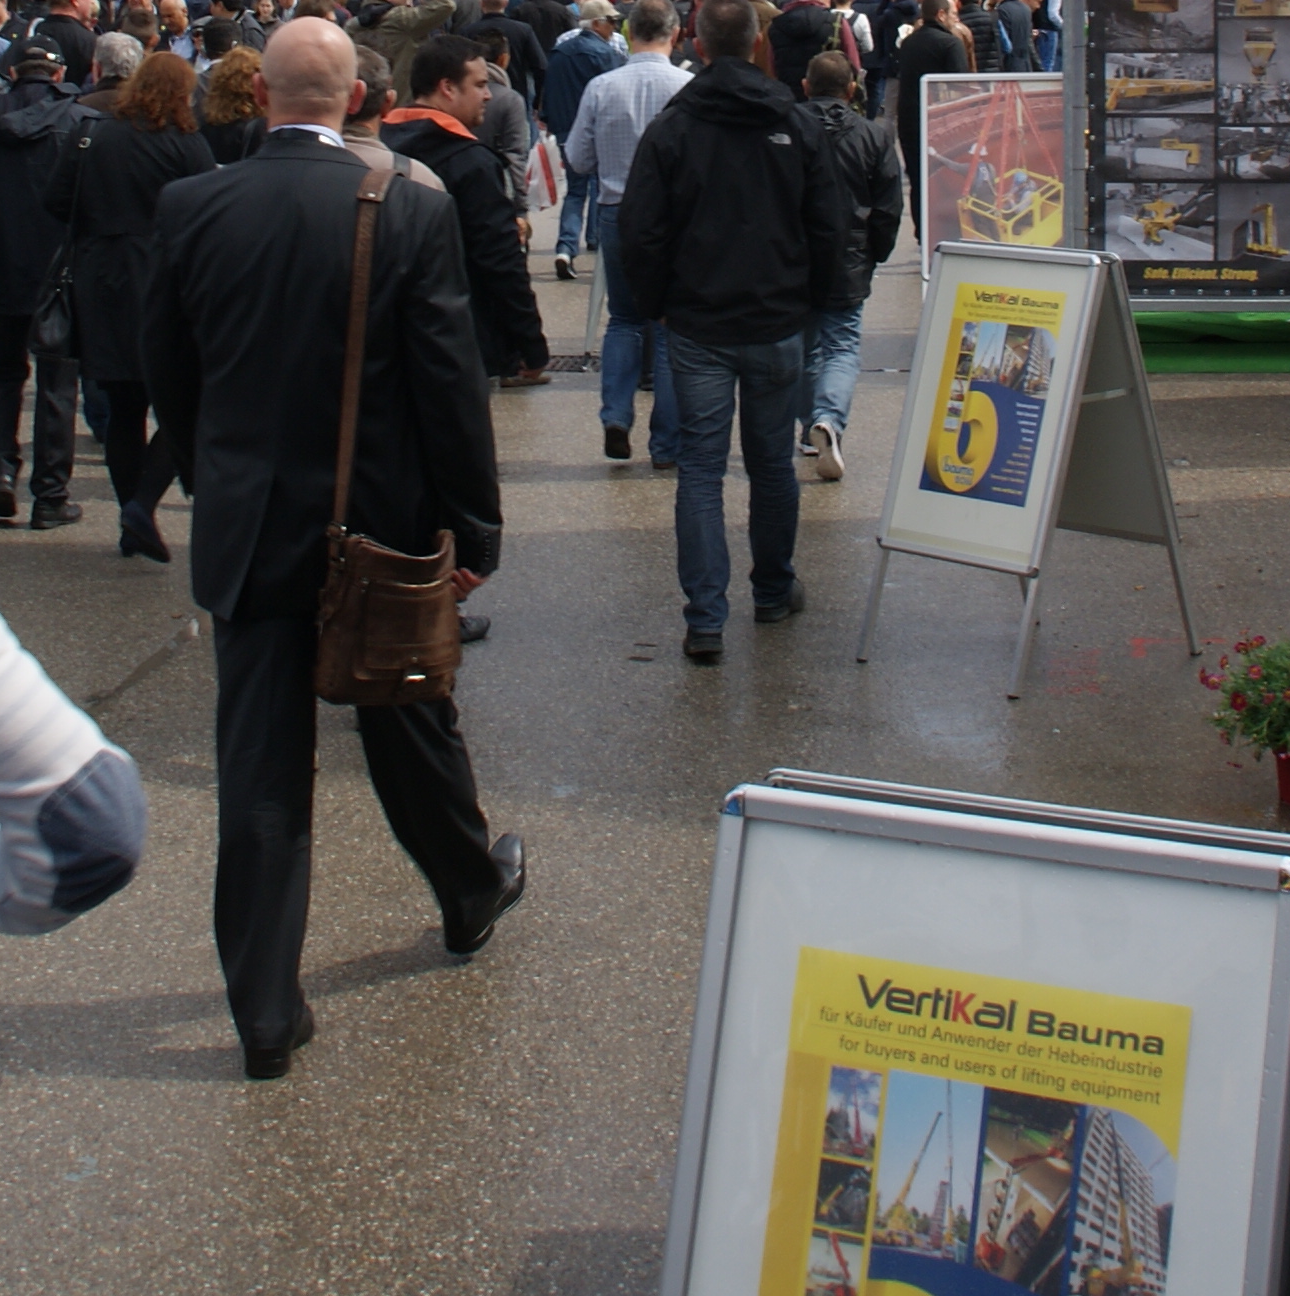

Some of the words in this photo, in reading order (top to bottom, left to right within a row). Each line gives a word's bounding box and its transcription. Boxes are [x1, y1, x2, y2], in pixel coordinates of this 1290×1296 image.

[974, 289, 1020, 306] VertiKal
[1021, 297, 1059, 309] Bauma
[1143, 267, 1169, 279] Safe.
[1171, 267, 1218, 279] Efficient.
[1220, 267, 1258, 281] Strong.
[819, 1007, 839, 1024] für
[844, 1010, 893, 1033] Käufer
[897, 1022, 927, 1040] und
[931, 1027, 1012, 1055] Anwender
[1017, 1042, 1044, 1060] der
[1048, 1047, 1163, 1079] Hebeindustrie
[857, 974, 1017, 1032] VertiKal
[1026, 1009, 1165, 1055] Bauma
[838, 1035, 859, 1051] for
[864, 1038, 916, 1064] buyers
[920, 1051, 950, 1069] and
[954, 1057, 997, 1077] users
[1001, 1064, 1018, 1081] of
[1022, 1066, 1065, 1093] lifting
[1070, 1078, 1161, 1105] equipment
